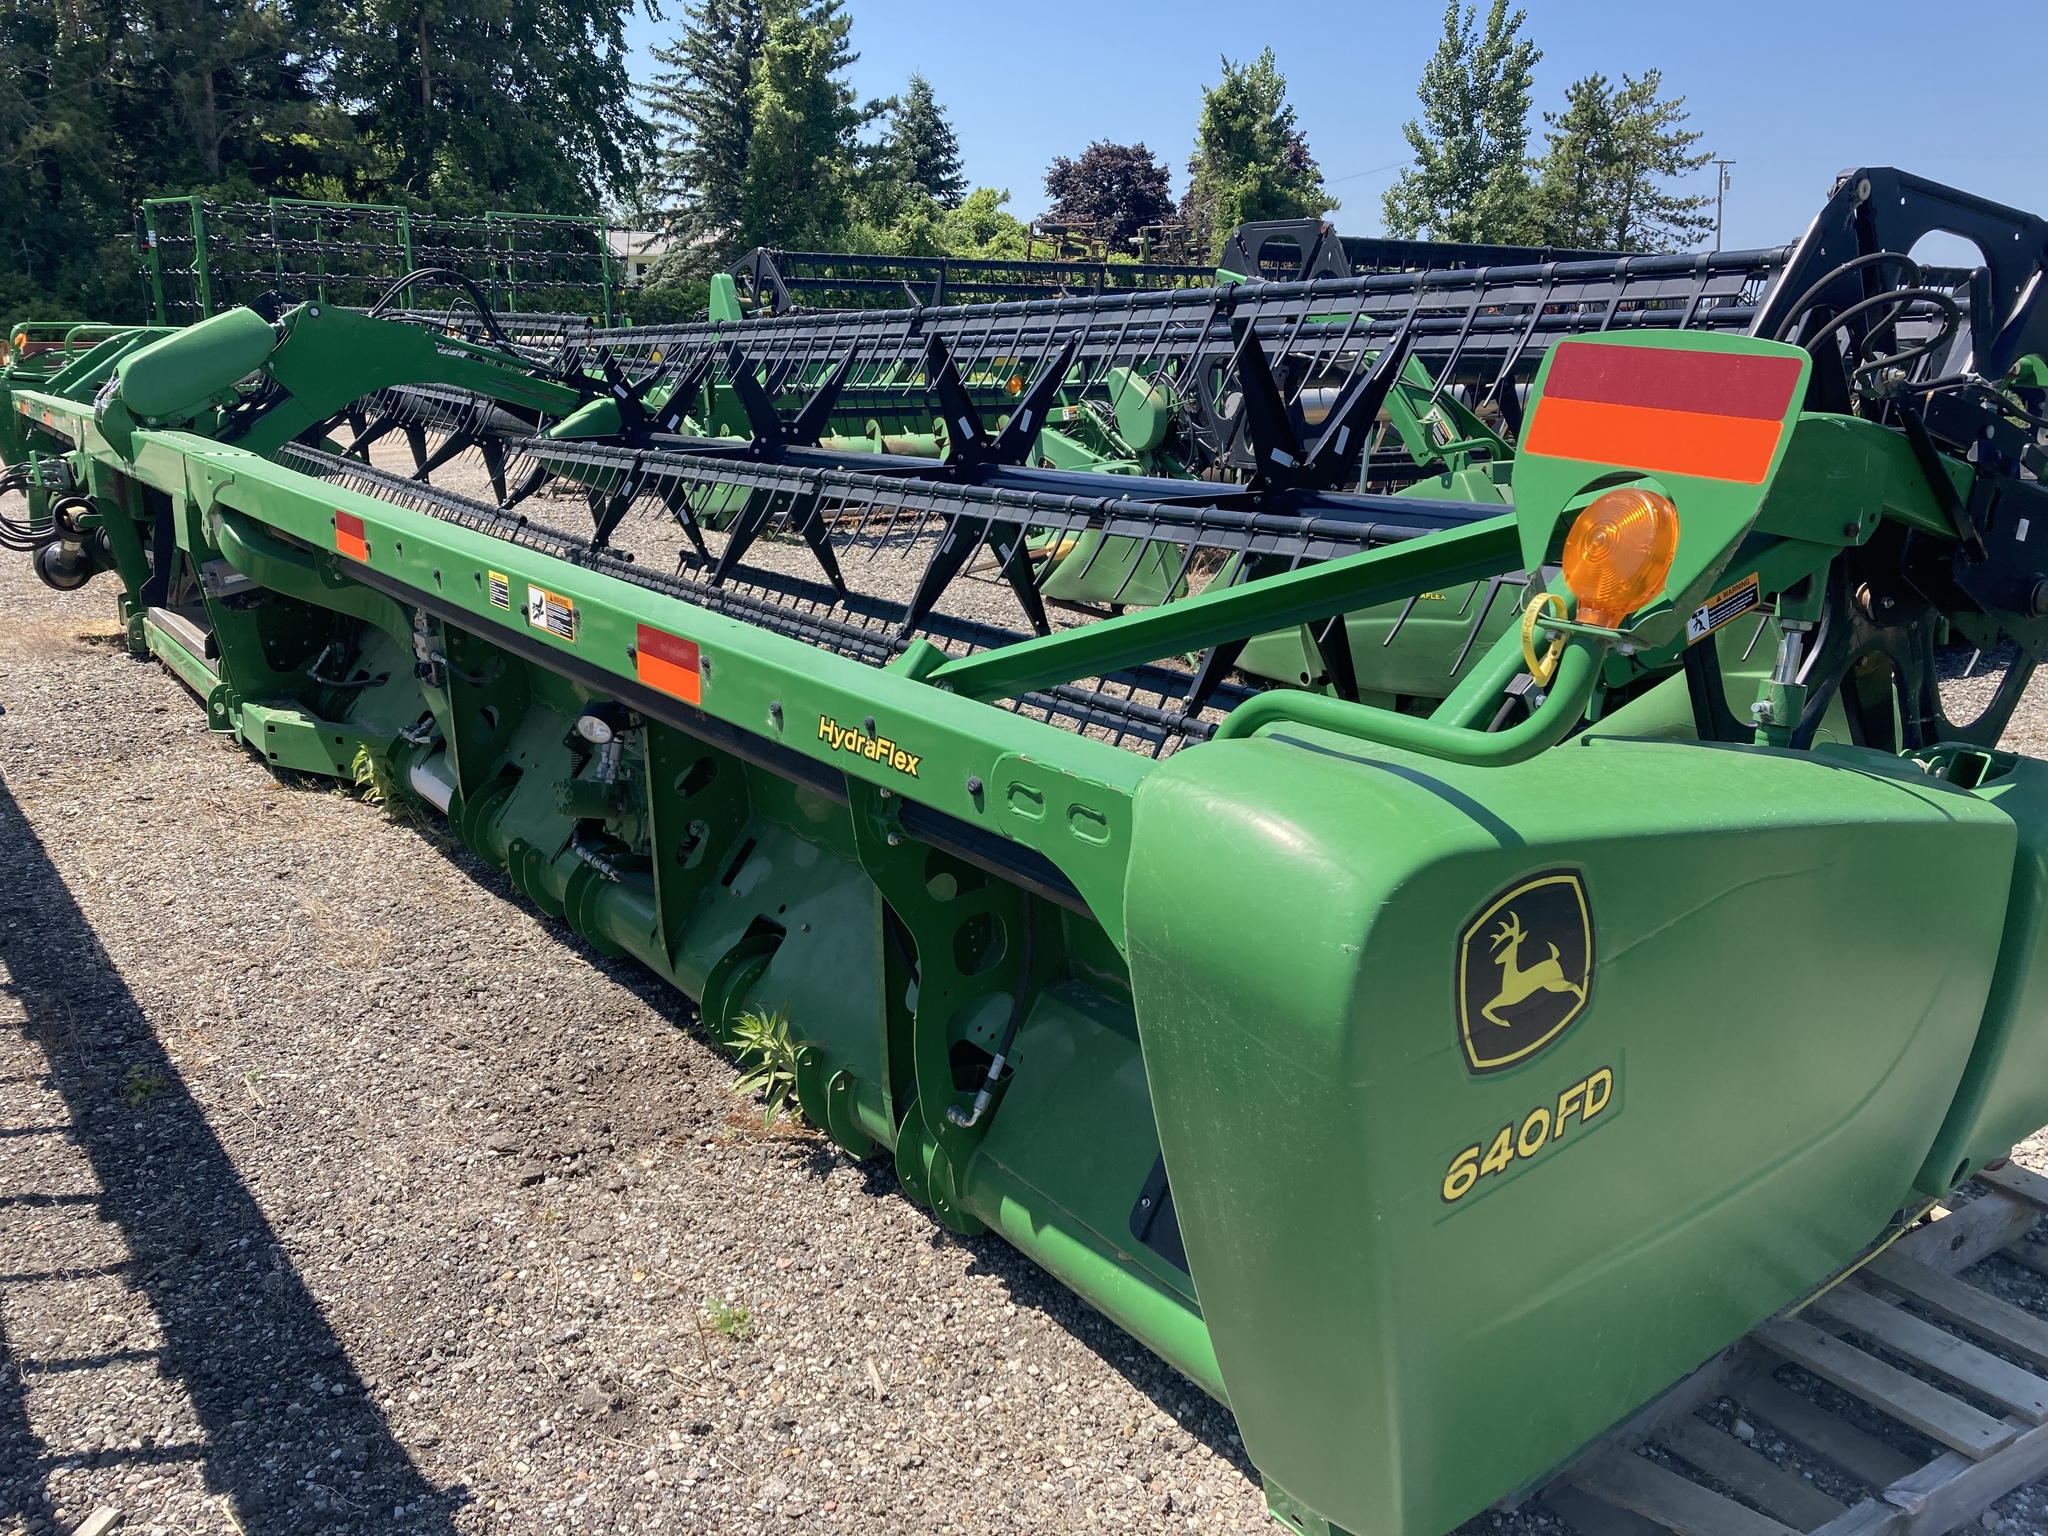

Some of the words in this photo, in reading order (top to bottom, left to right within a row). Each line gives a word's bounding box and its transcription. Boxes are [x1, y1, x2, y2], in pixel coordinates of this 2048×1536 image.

[1419, 592, 1447, 601] AFLEX
[1722, 578, 1751, 598] WARNING
[1522, 600, 1540, 644] TRI-COUNTY
[818, 713, 923, 779] HydraFlex
[1441, 1065, 1614, 1203] 640FD
